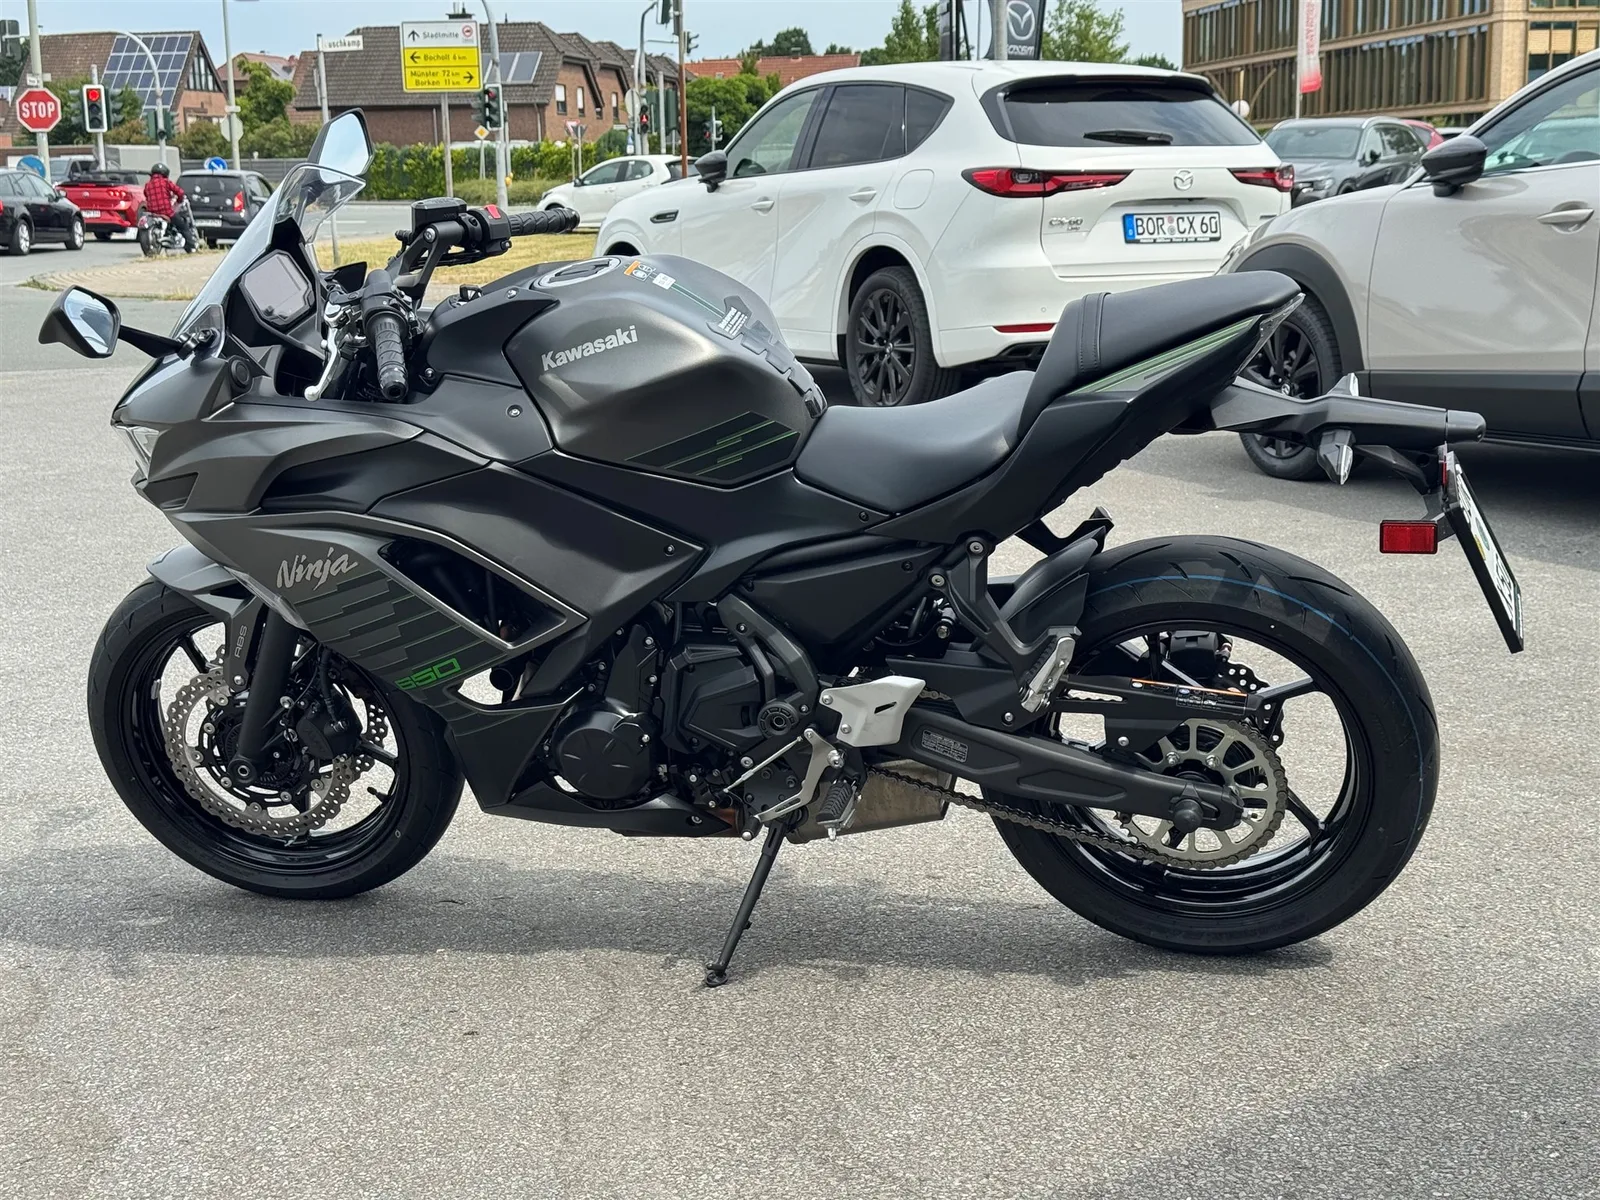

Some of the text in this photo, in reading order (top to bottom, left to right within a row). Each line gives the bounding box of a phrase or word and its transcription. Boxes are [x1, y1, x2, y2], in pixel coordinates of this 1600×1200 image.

[422, 31, 459, 39] Stadtmitte
[423, 53, 450, 61] Bocholt
[21, 101, 55, 119] STOP
[1135, 217, 1166, 235] BOR
[1176, 216, 1197, 234] CX
[1200, 216, 1218, 234] 60
[541, 325, 638, 371] Kawasaki
[276, 547, 358, 591] Ninja
[234, 625, 248, 658] ABS
